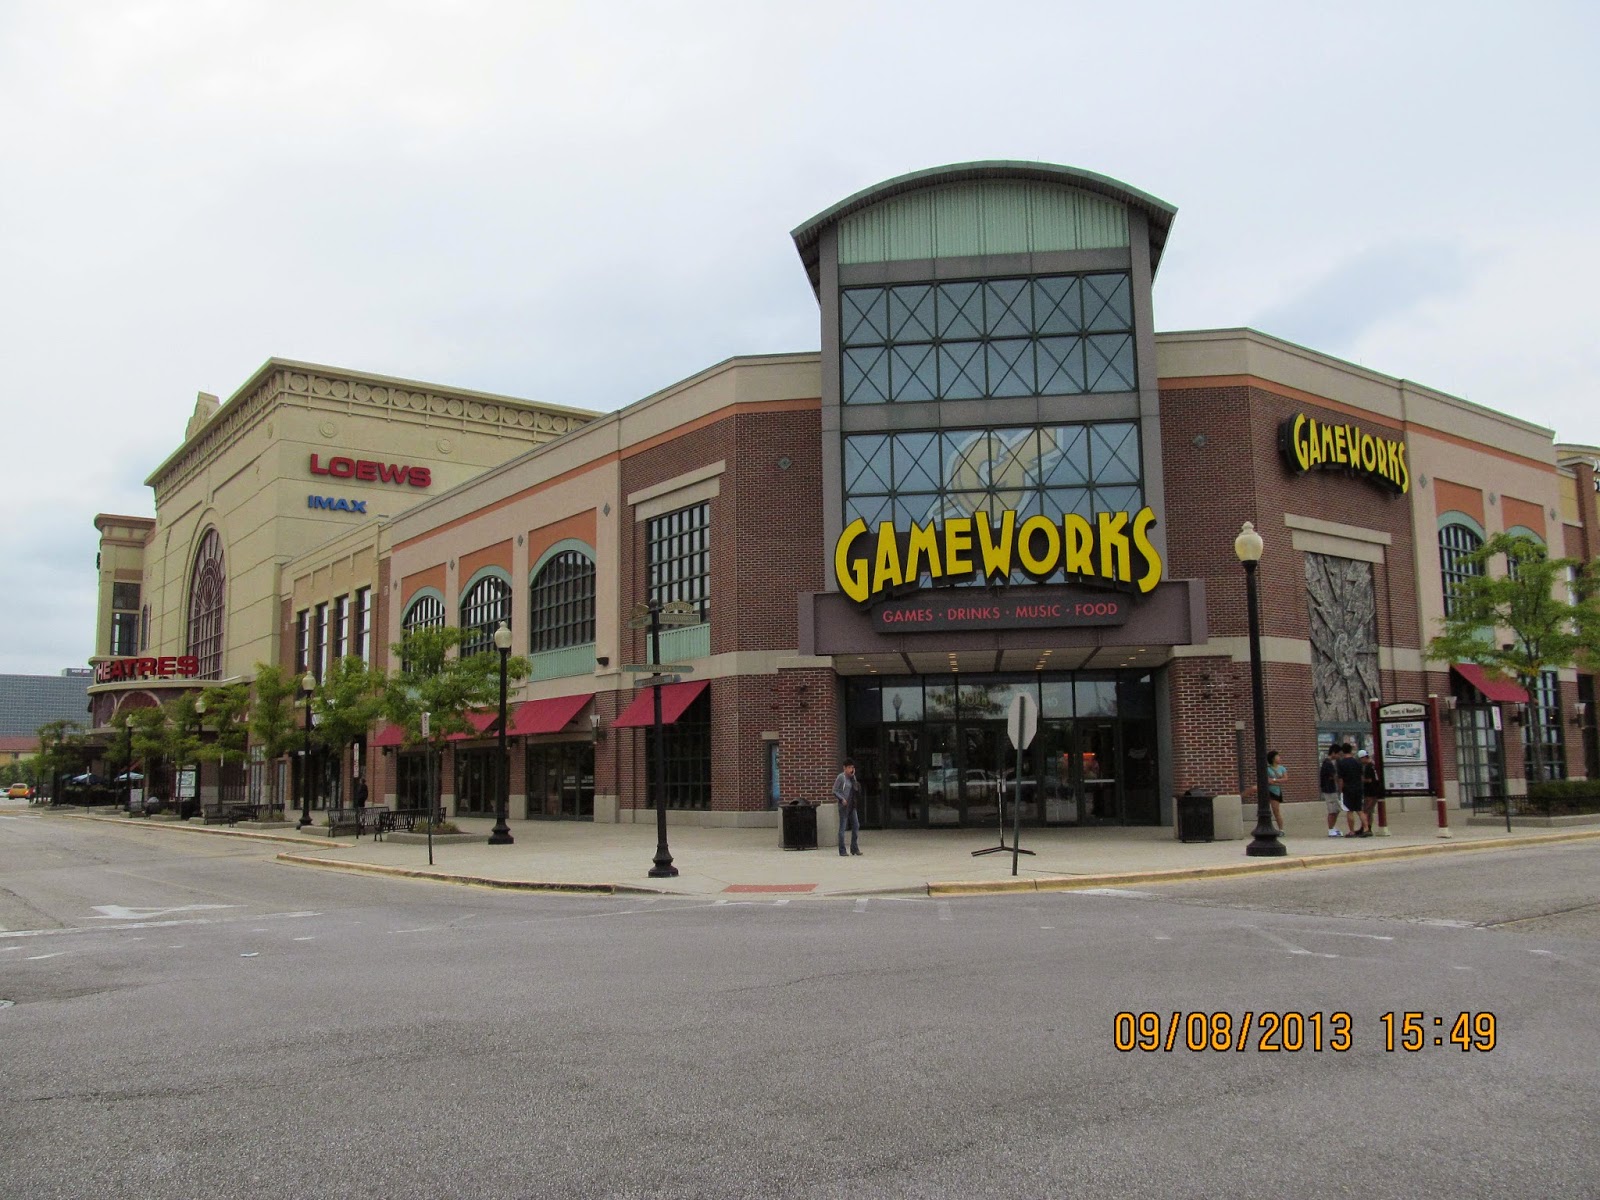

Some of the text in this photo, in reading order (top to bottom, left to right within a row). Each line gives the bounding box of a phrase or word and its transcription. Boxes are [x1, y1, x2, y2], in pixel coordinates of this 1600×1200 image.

[310, 453, 432, 488] LOEWS
[1293, 412, 1410, 494] GAMEWORKS
[308, 494, 368, 513] IMAX
[834, 505, 1163, 603] GAMEWORKS
[882, 603, 1118, 623] GAMES DRINKS MUSIC FOOD
